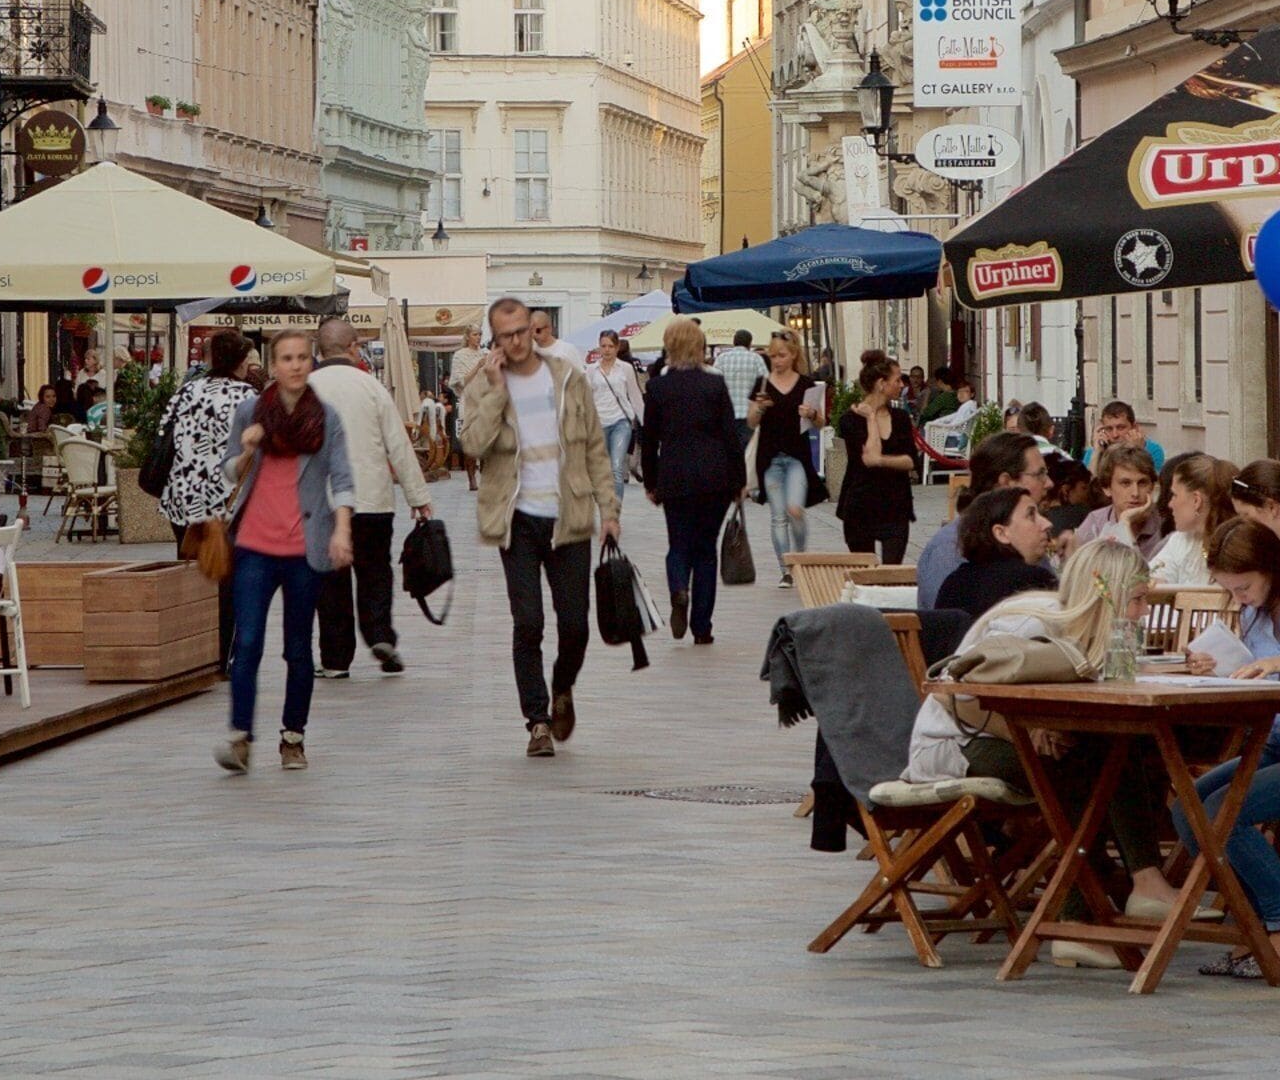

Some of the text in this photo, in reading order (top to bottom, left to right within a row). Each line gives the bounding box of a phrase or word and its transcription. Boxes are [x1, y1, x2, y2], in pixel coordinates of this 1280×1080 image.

[951, 7, 1016, 21] COUNCIL
[921, 84, 937, 95] CT
[940, 84, 993, 95] GALLERY
[936, 159, 996, 168] RESTAURANT
[113, 272, 157, 289] pepsi
[261, 269, 304, 286] pepsi
[975, 260, 1051, 287] Urpiner
[215, 315, 281, 326] LOENSKA
